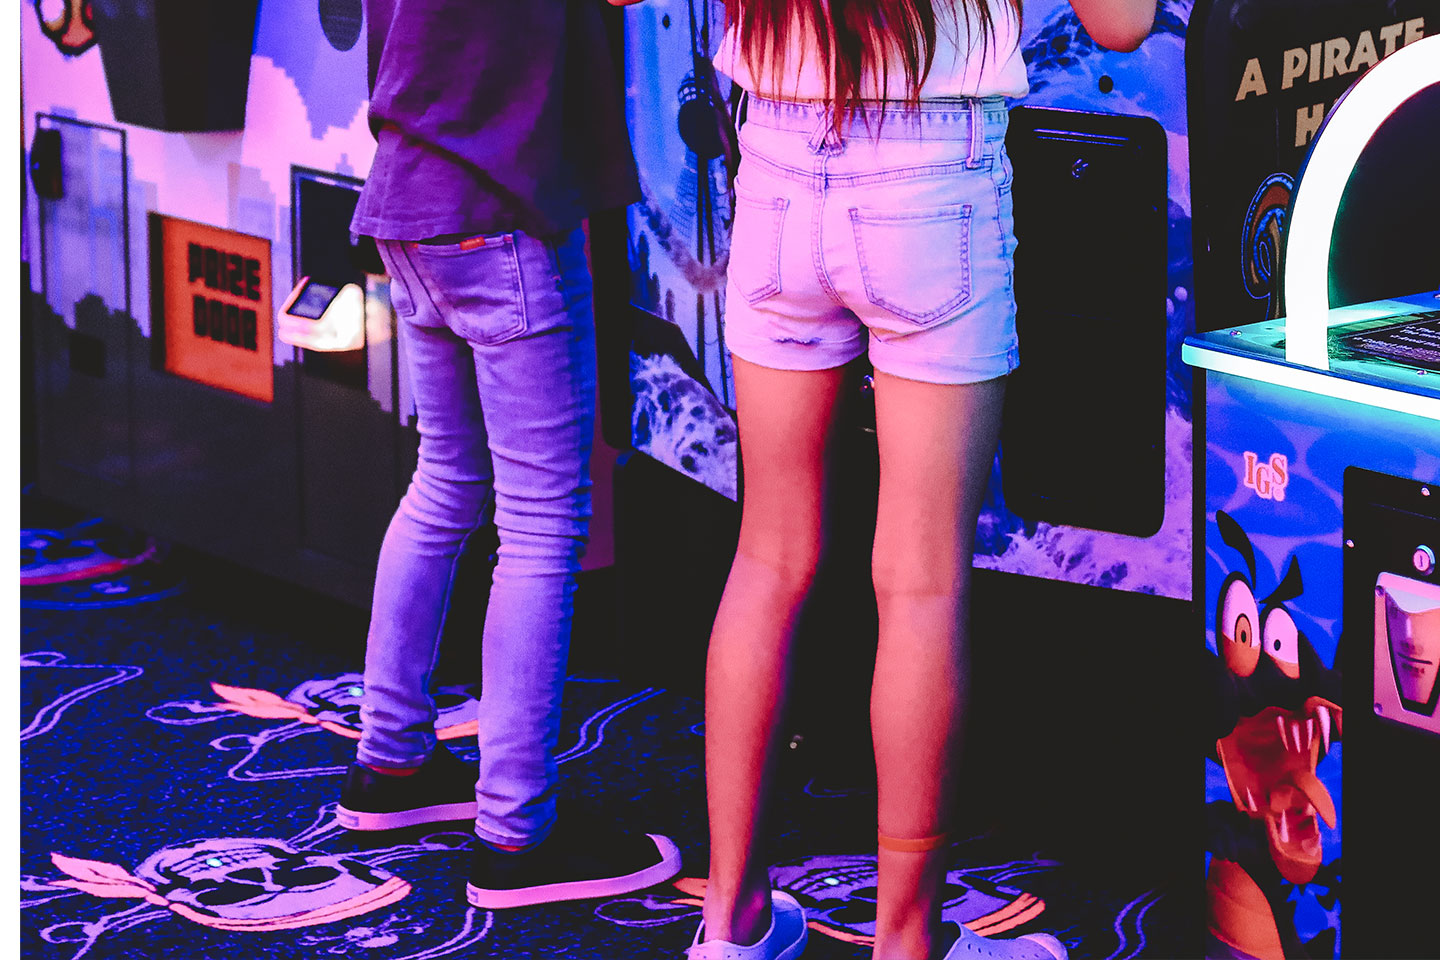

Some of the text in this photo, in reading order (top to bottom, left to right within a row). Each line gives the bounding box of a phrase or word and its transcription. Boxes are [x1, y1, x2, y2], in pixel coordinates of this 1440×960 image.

[1235, 17, 1426, 102] A PIRATE
[187, 241, 261, 302] PRIZE
[193, 294, 258, 352] DOOR
[1245, 452, 1288, 498] IGS
